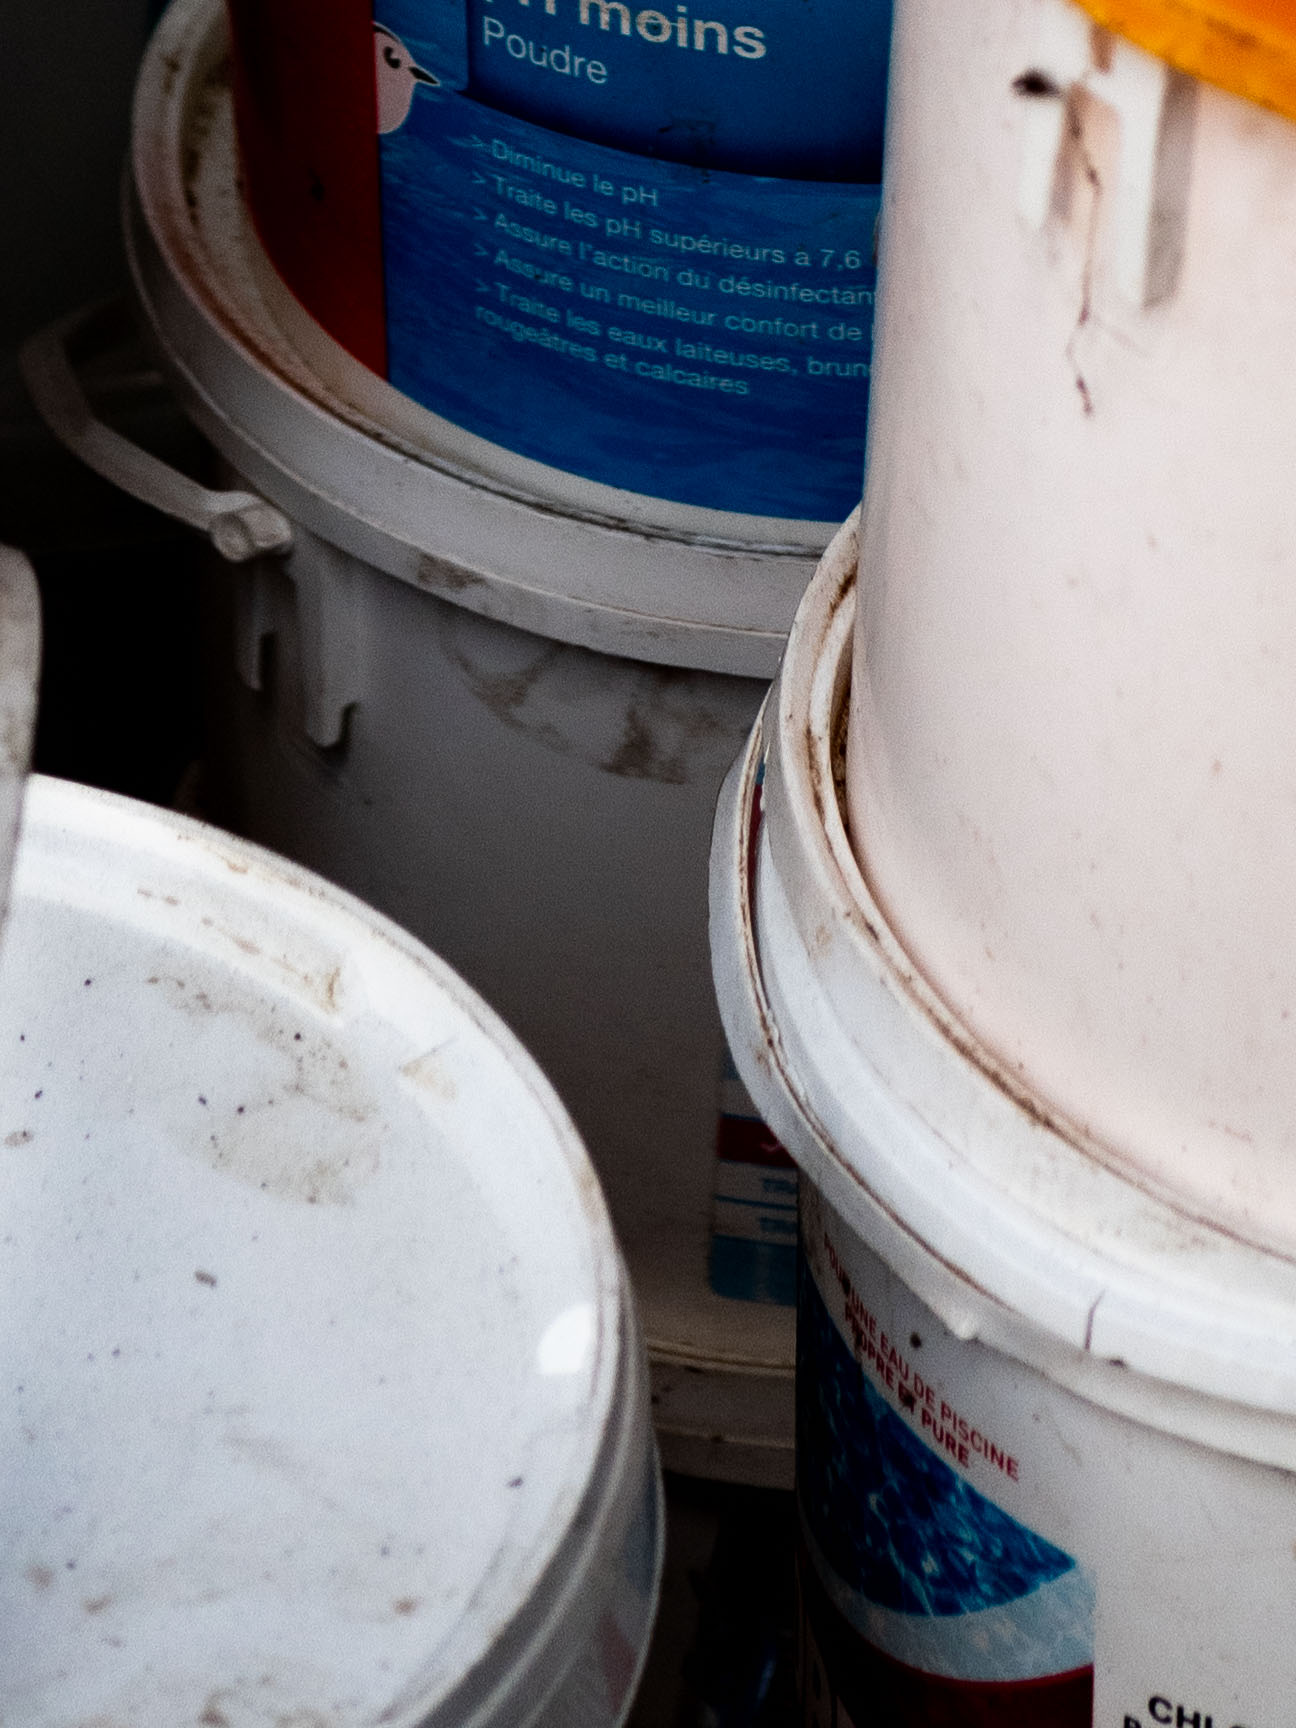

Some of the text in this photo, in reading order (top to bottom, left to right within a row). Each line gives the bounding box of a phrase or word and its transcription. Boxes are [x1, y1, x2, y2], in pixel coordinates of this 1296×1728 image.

[484, 16, 609, 85] Poudre
[593, 174, 614, 196] le
[622, 187, 659, 207] pH
[914, 1373, 935, 1407] DE
[941, 1400, 1019, 1483] PISCINE
[921, 1407, 969, 1468] PURE
